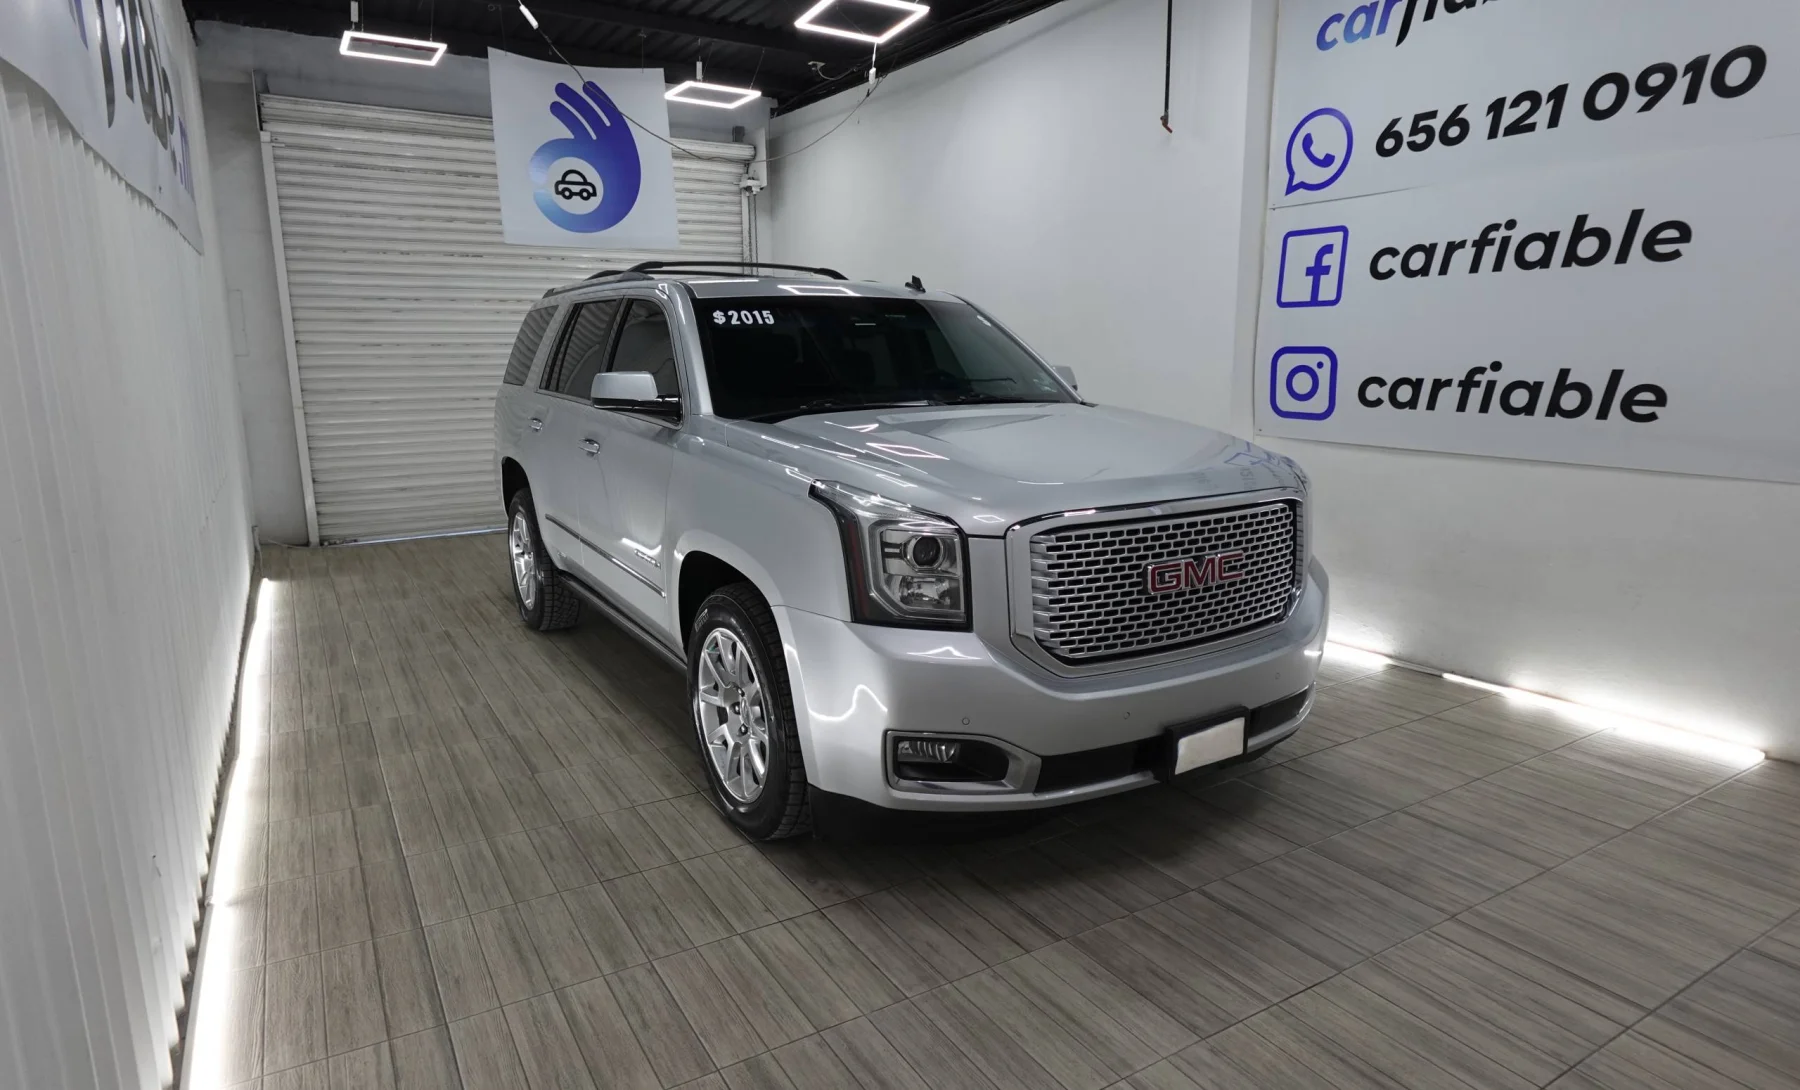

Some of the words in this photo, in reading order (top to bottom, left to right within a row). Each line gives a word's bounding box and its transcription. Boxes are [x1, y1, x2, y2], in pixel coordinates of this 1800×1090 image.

[1375, 103, 1470, 158] 656
[1485, 82, 1569, 141] 121
[1582, 44, 1768, 122] 0910
[1368, 208, 1693, 281] carfiable
[1356, 360, 1669, 424] carfiable
[1147, 549, 1245, 595] GMC
